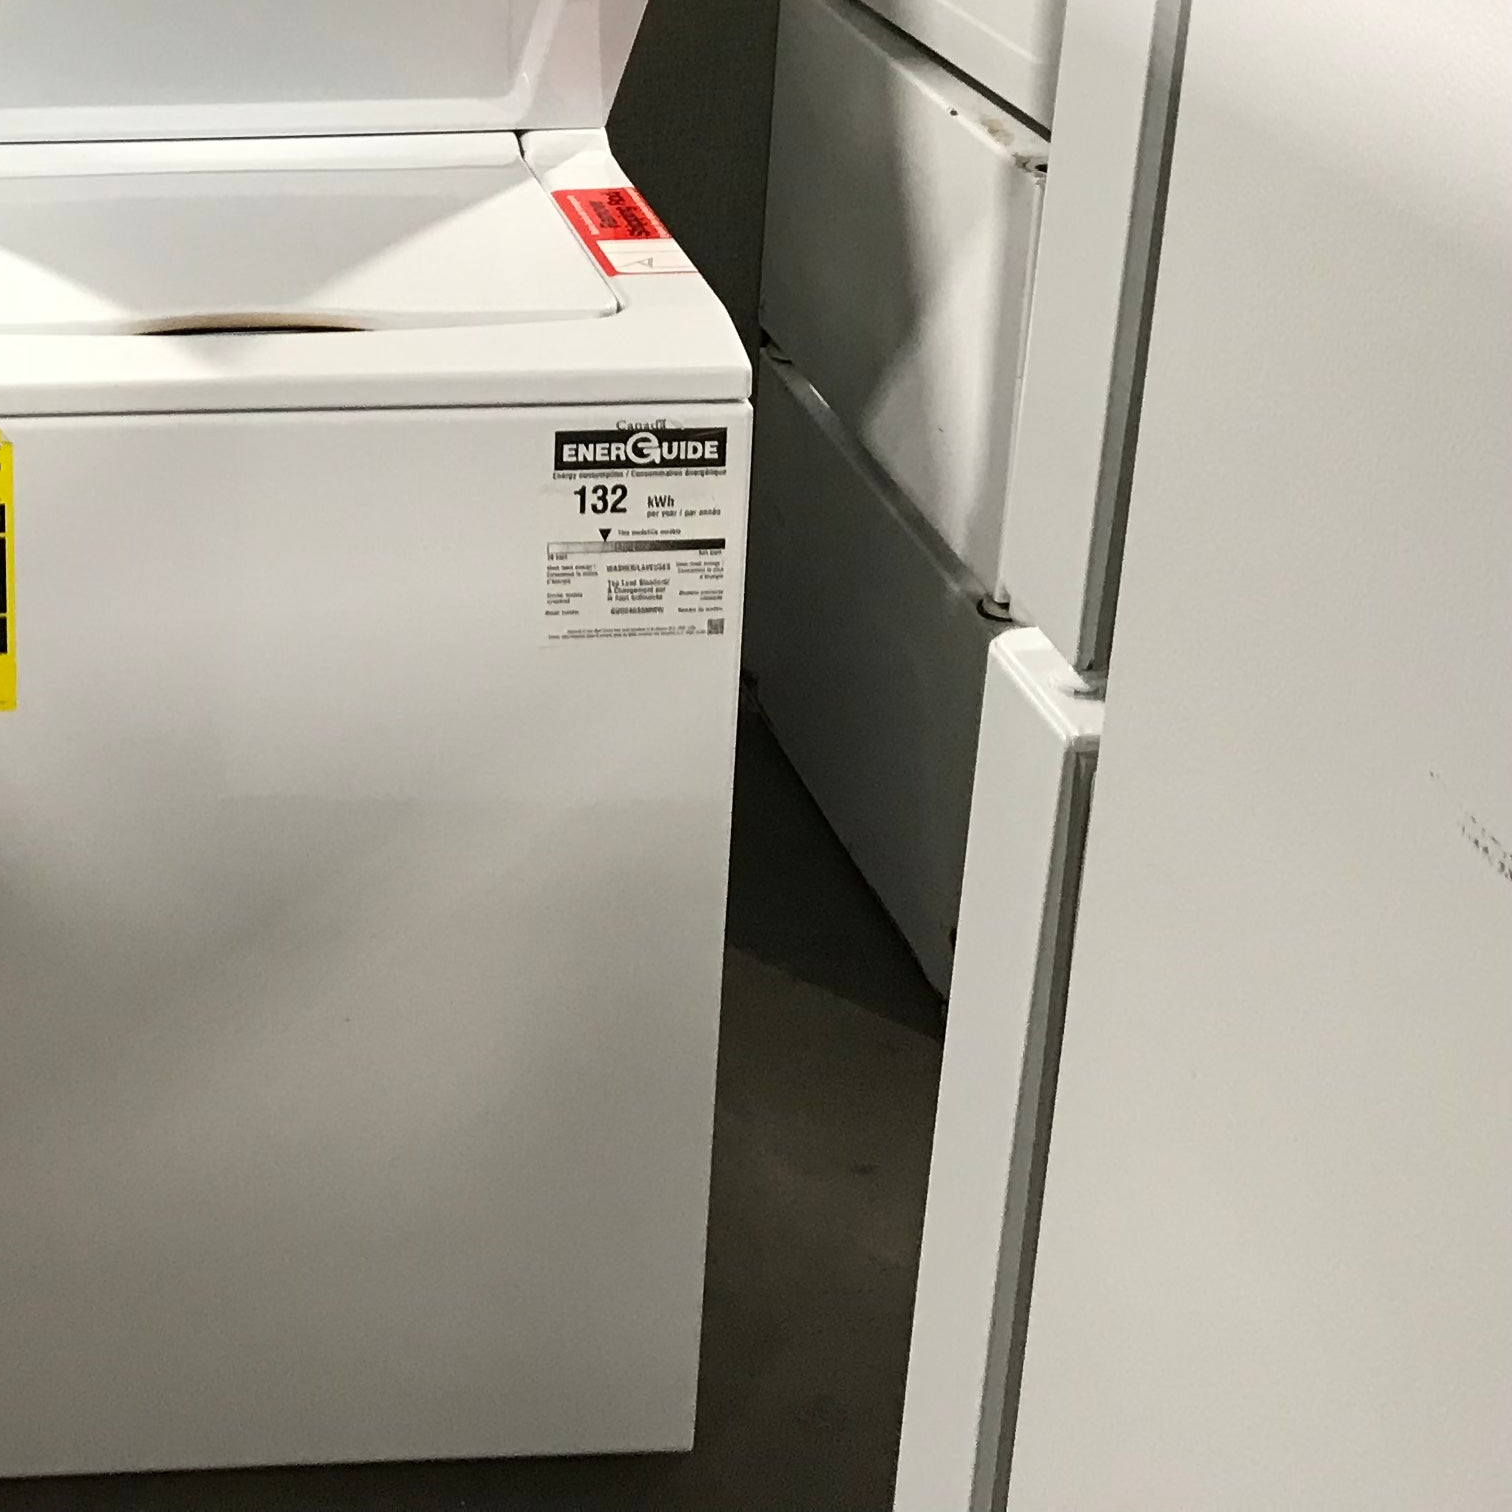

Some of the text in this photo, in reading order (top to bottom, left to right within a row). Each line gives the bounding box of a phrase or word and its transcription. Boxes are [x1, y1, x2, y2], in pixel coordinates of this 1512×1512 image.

[562, 431, 719, 465] ENERGUIDE
[553, 472, 577, 480] Energy
[574, 484, 628, 515] 132
[647, 495, 675, 509] kWh
[662, 510, 677, 518] year
